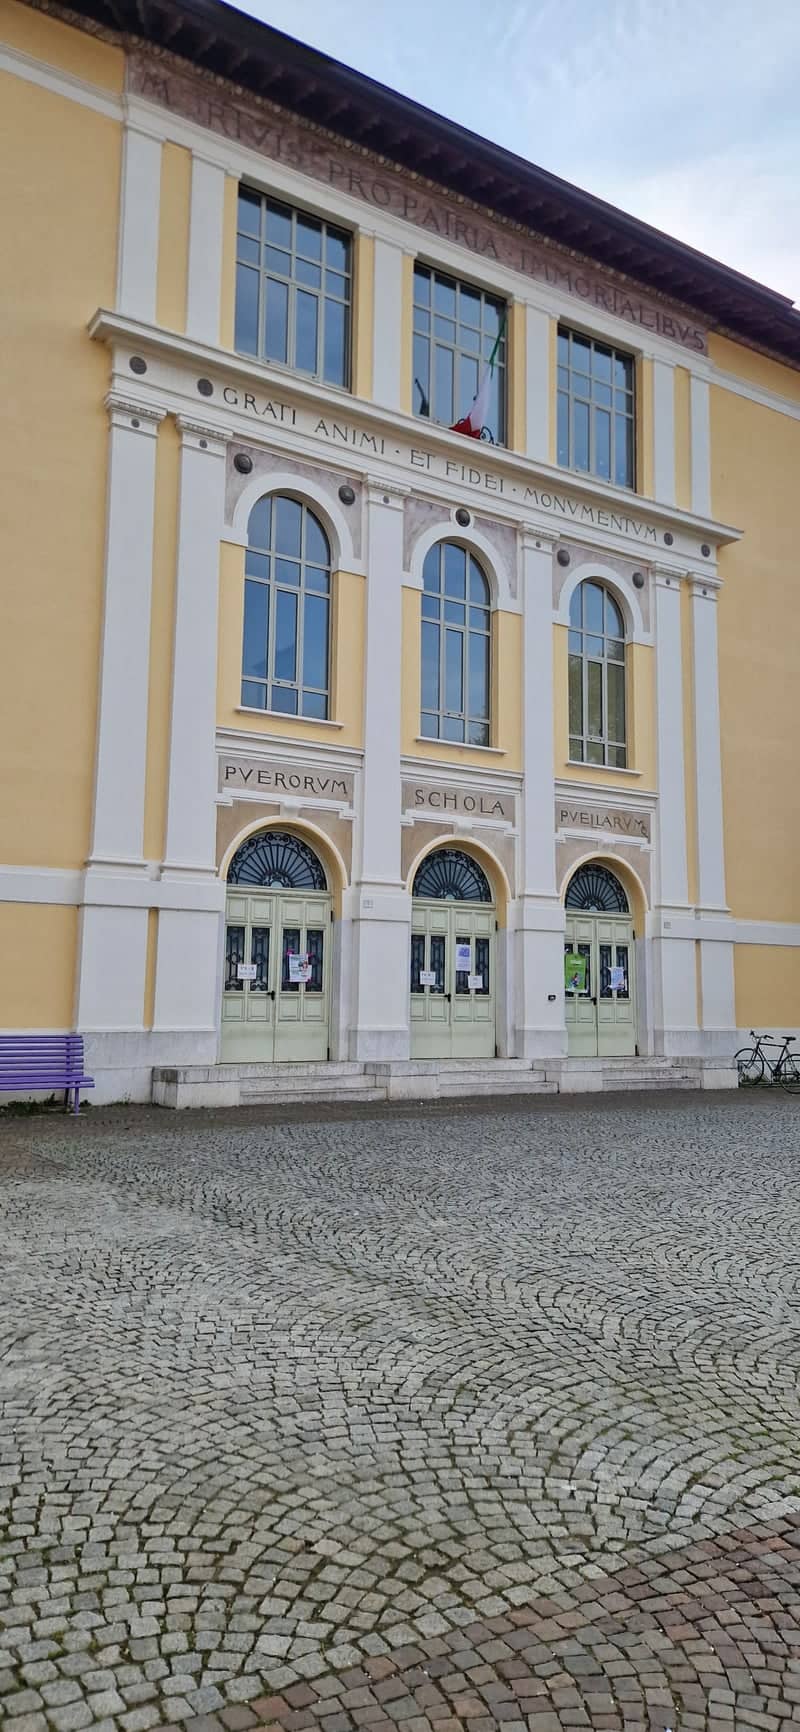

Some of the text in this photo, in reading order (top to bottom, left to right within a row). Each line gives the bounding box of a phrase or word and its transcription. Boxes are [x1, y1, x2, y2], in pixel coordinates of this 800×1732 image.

[328, 160, 392, 207] PRO
[402, 196, 498, 258] PATRIA
[223, 387, 658, 542] GRATI ANIMI ET FIDEI MONVMENTVM
[225, 766, 348, 795] PVERORVM
[414, 789, 505, 816] SCHOLA
